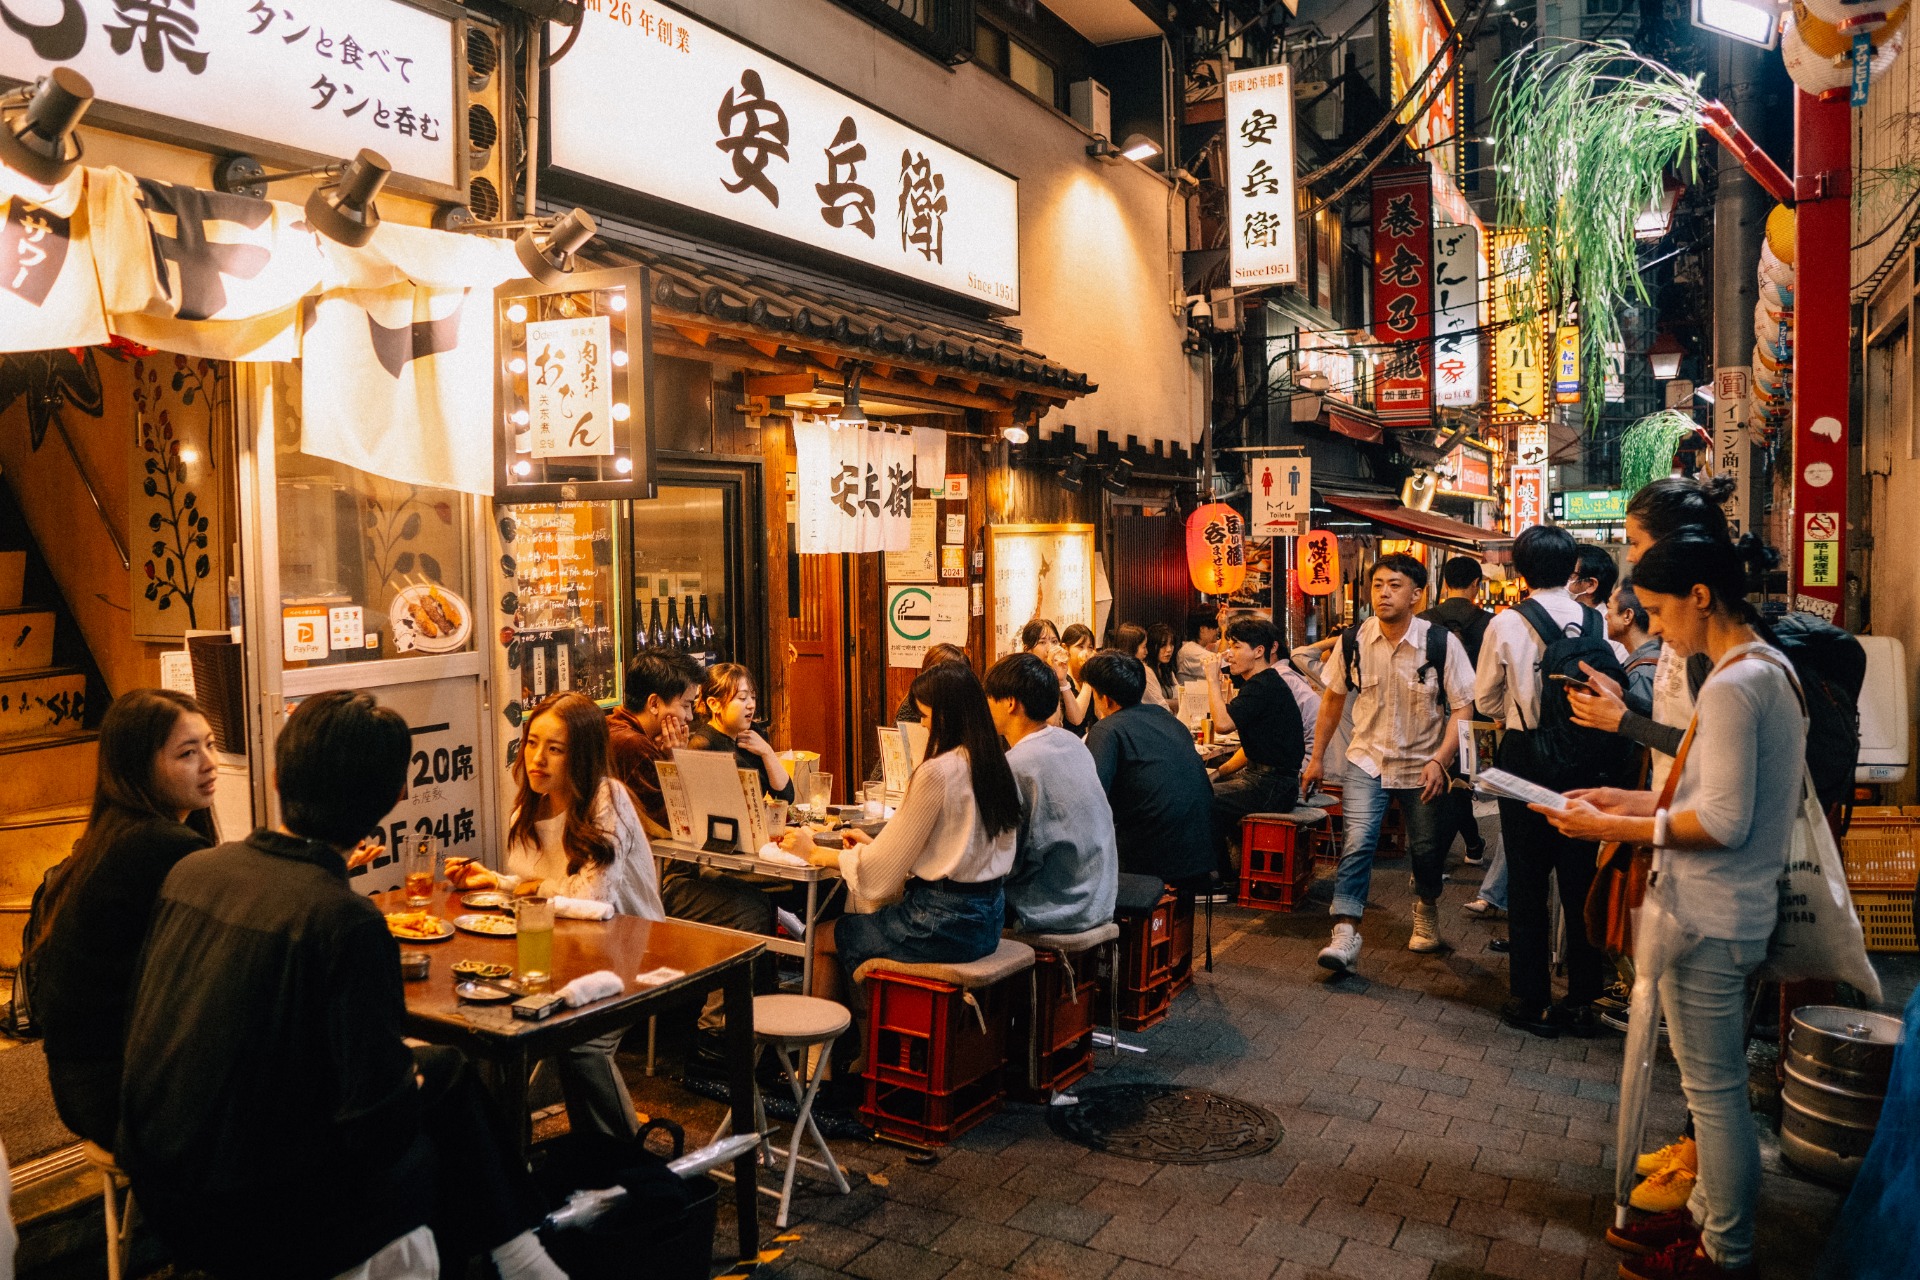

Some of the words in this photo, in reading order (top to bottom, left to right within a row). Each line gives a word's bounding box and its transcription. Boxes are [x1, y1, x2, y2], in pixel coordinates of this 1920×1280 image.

[246, 0, 414, 84] タンと食べて
[309, 73, 440, 142] タンと呑む
[1240, 108, 1281, 250] 安兵衛
[967, 270, 993, 296] Since
[994, 279, 1015, 303] 1951
[578, 340, 600, 402] 肉出汁
[534, 343, 603, 448] おでん
[1384, 389, 1423, 402] 加盟店
[830, 459, 913, 519] 安兵衛
[1266, 501, 1295, 511] トイレ
[943, 568, 960, 577] 2024
[1813, 542, 1829, 583] 路上喫煙禁止
[293, 645, 320, 653] PayPay
[411, 786, 447, 806] お座敷
